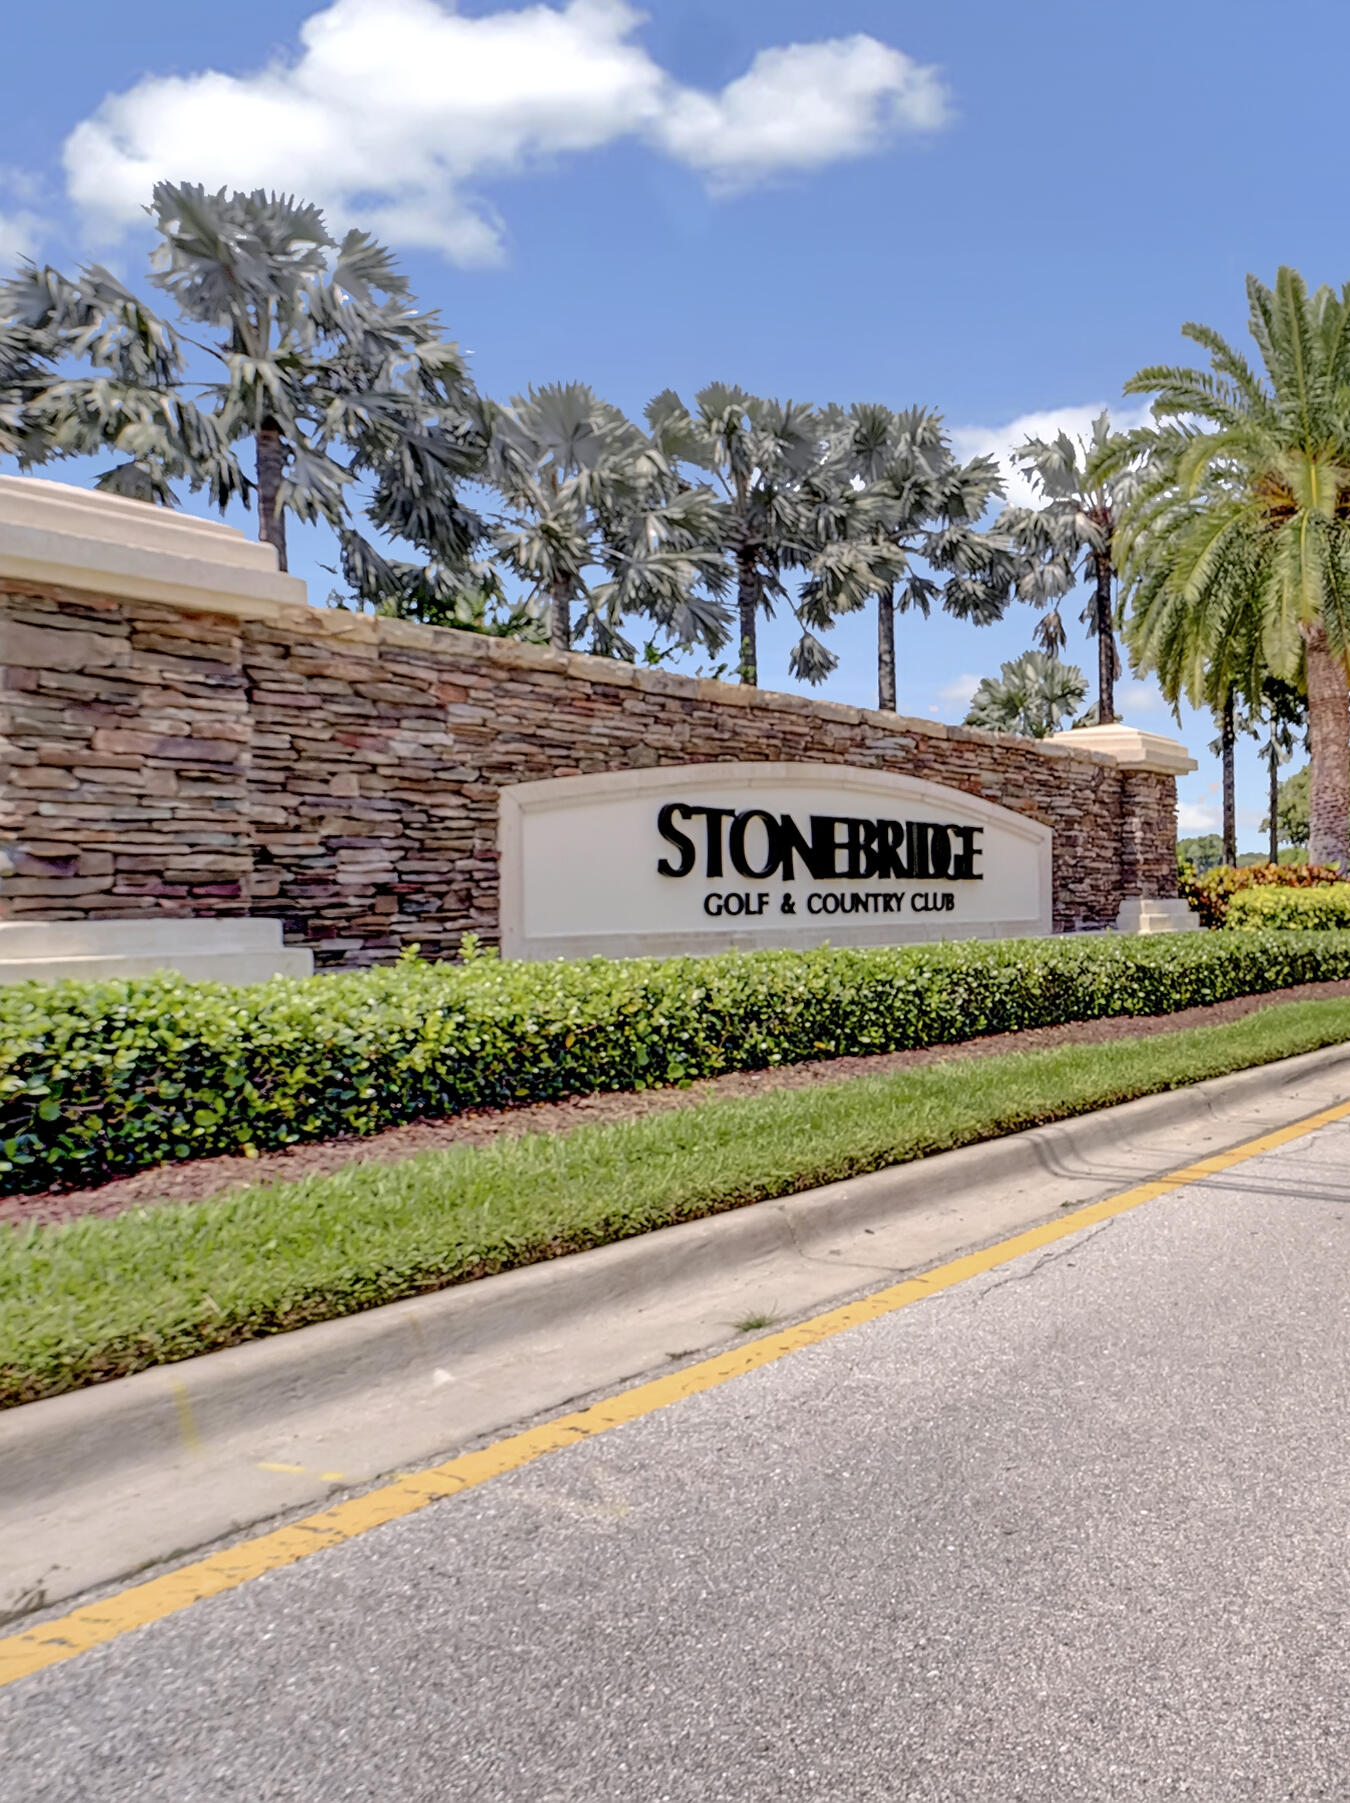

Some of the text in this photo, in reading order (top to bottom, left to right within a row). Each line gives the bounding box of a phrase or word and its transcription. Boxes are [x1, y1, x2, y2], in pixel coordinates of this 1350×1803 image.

[657, 803, 984, 881] STONEBRIDGE
[703, 891, 955, 917] GOLF & COUNTRY CLUB
